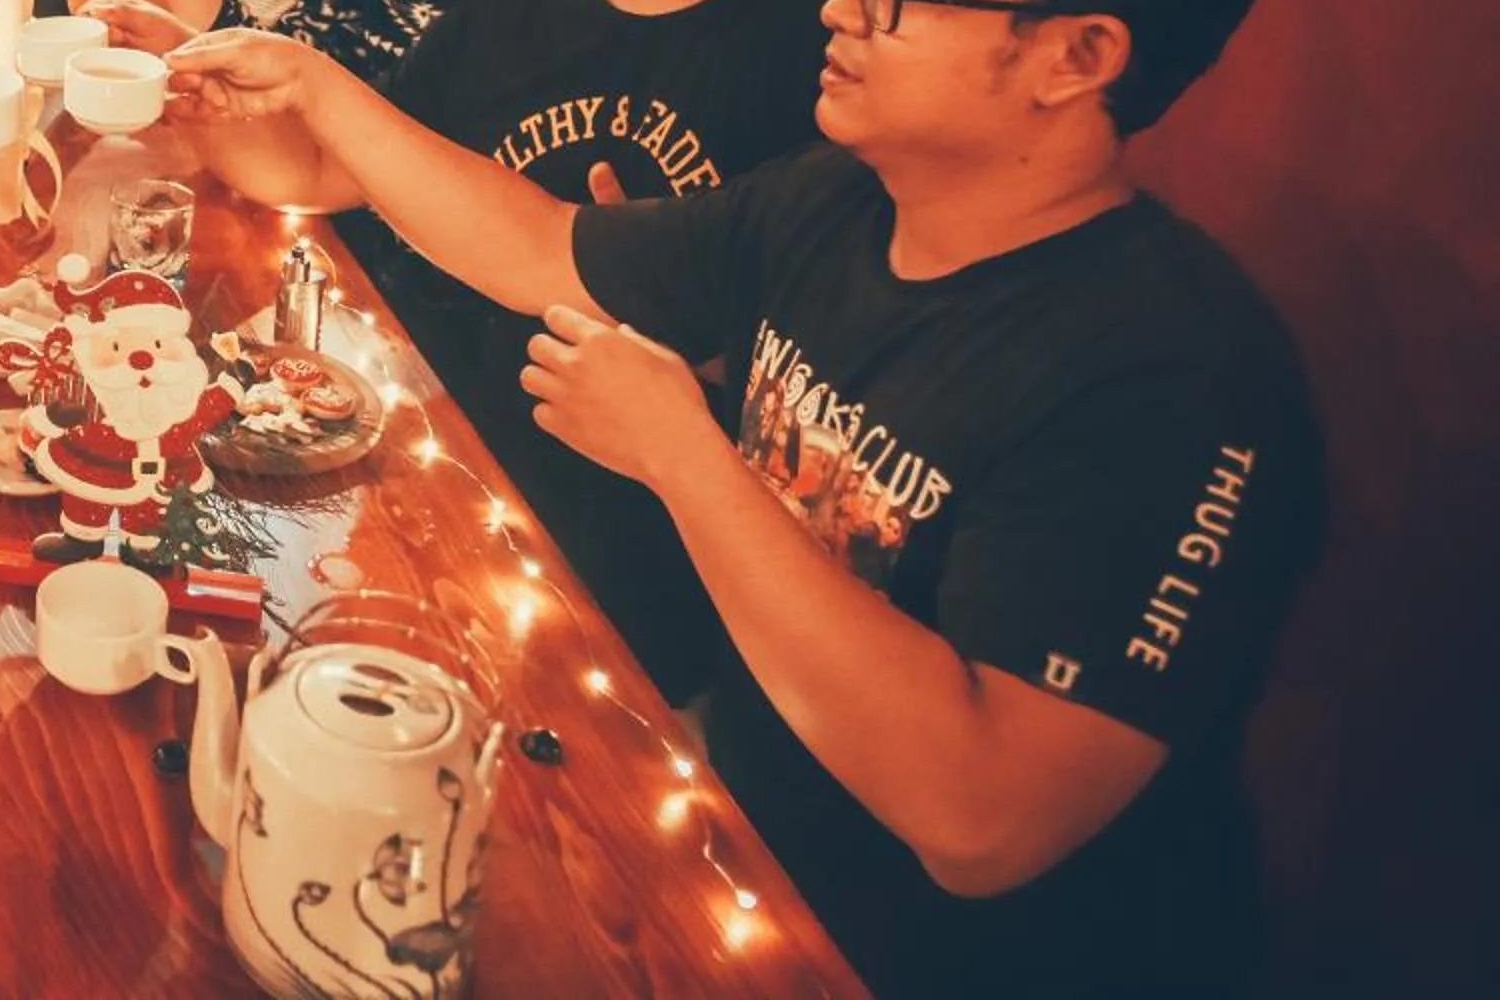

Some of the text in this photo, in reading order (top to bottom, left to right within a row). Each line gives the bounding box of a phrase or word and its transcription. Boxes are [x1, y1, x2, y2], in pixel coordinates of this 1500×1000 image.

[852, 425, 953, 520] CLUB
[1126, 445, 1254, 671] THUG LIFE
